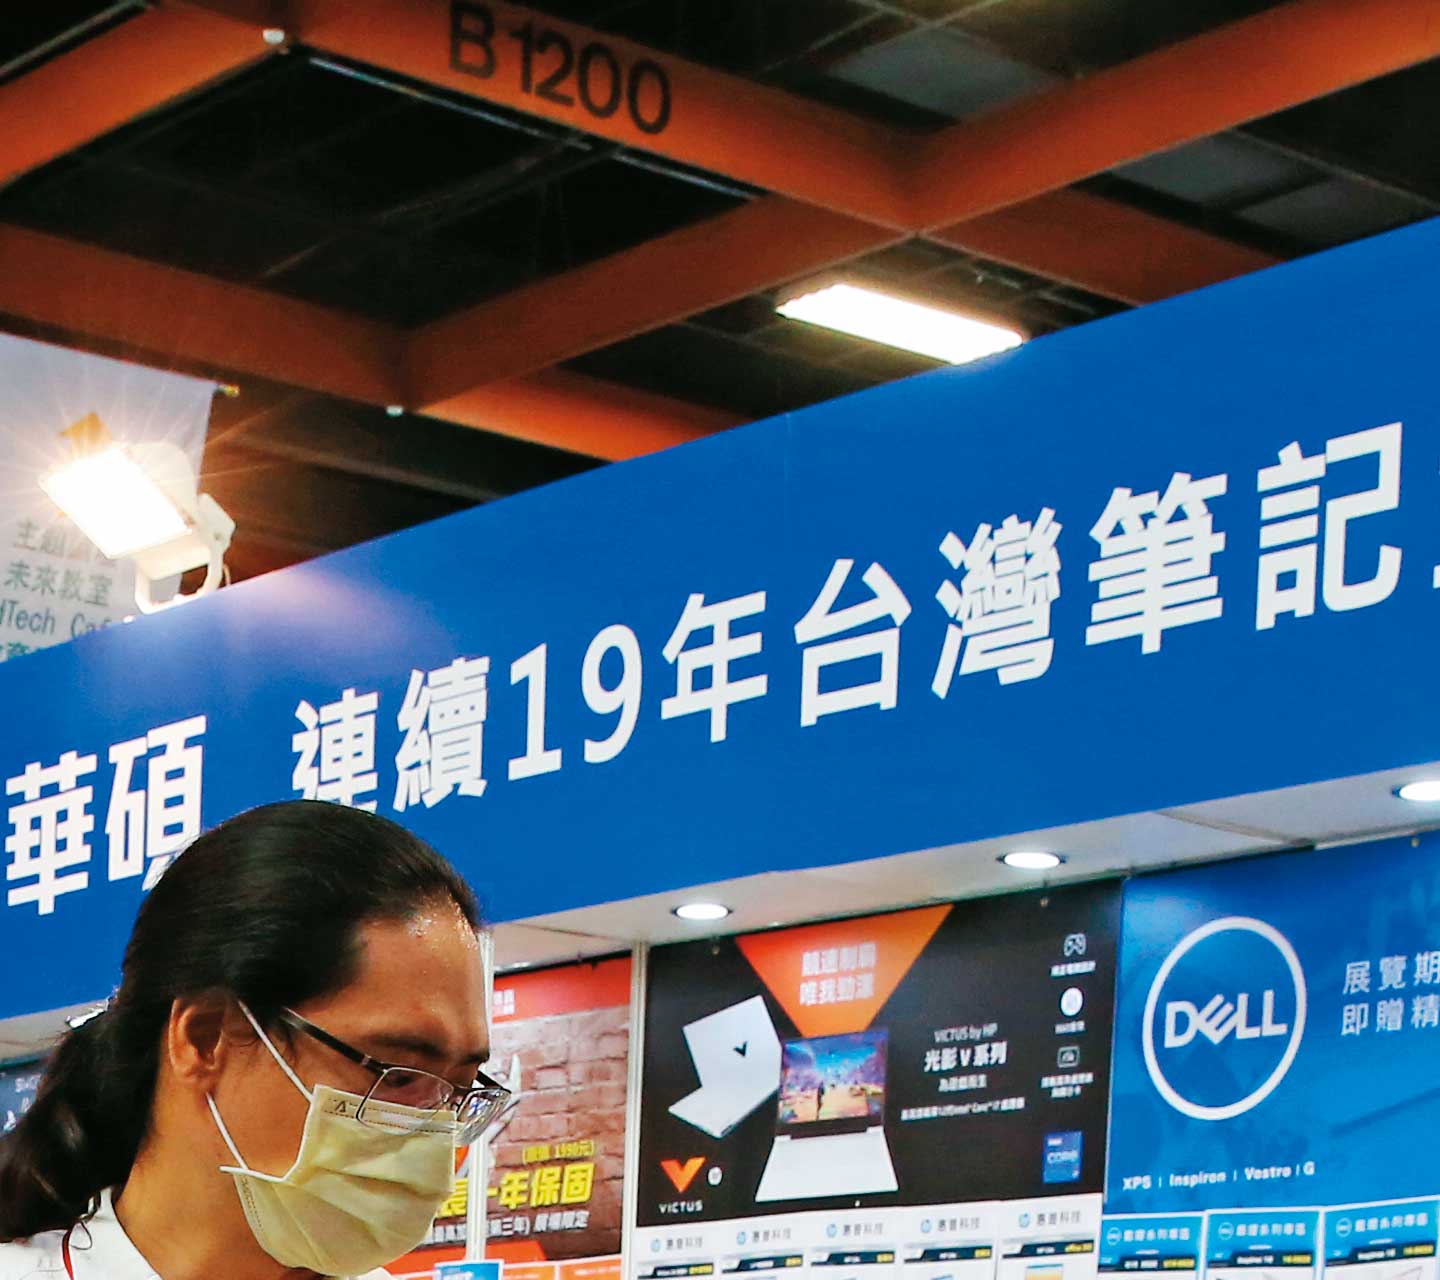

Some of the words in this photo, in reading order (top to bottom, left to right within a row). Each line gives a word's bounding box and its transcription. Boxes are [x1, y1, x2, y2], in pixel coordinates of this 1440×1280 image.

[4, 560, 112, 606] 未來教室
[5, 715, 207, 915] 華碩
[1164, 989, 1287, 1049] DELL
[1169, 1168, 1226, 1187] Inspiron
[1244, 1164, 1291, 1182] Vostro
[659, 1201, 703, 1215] VICTUS
